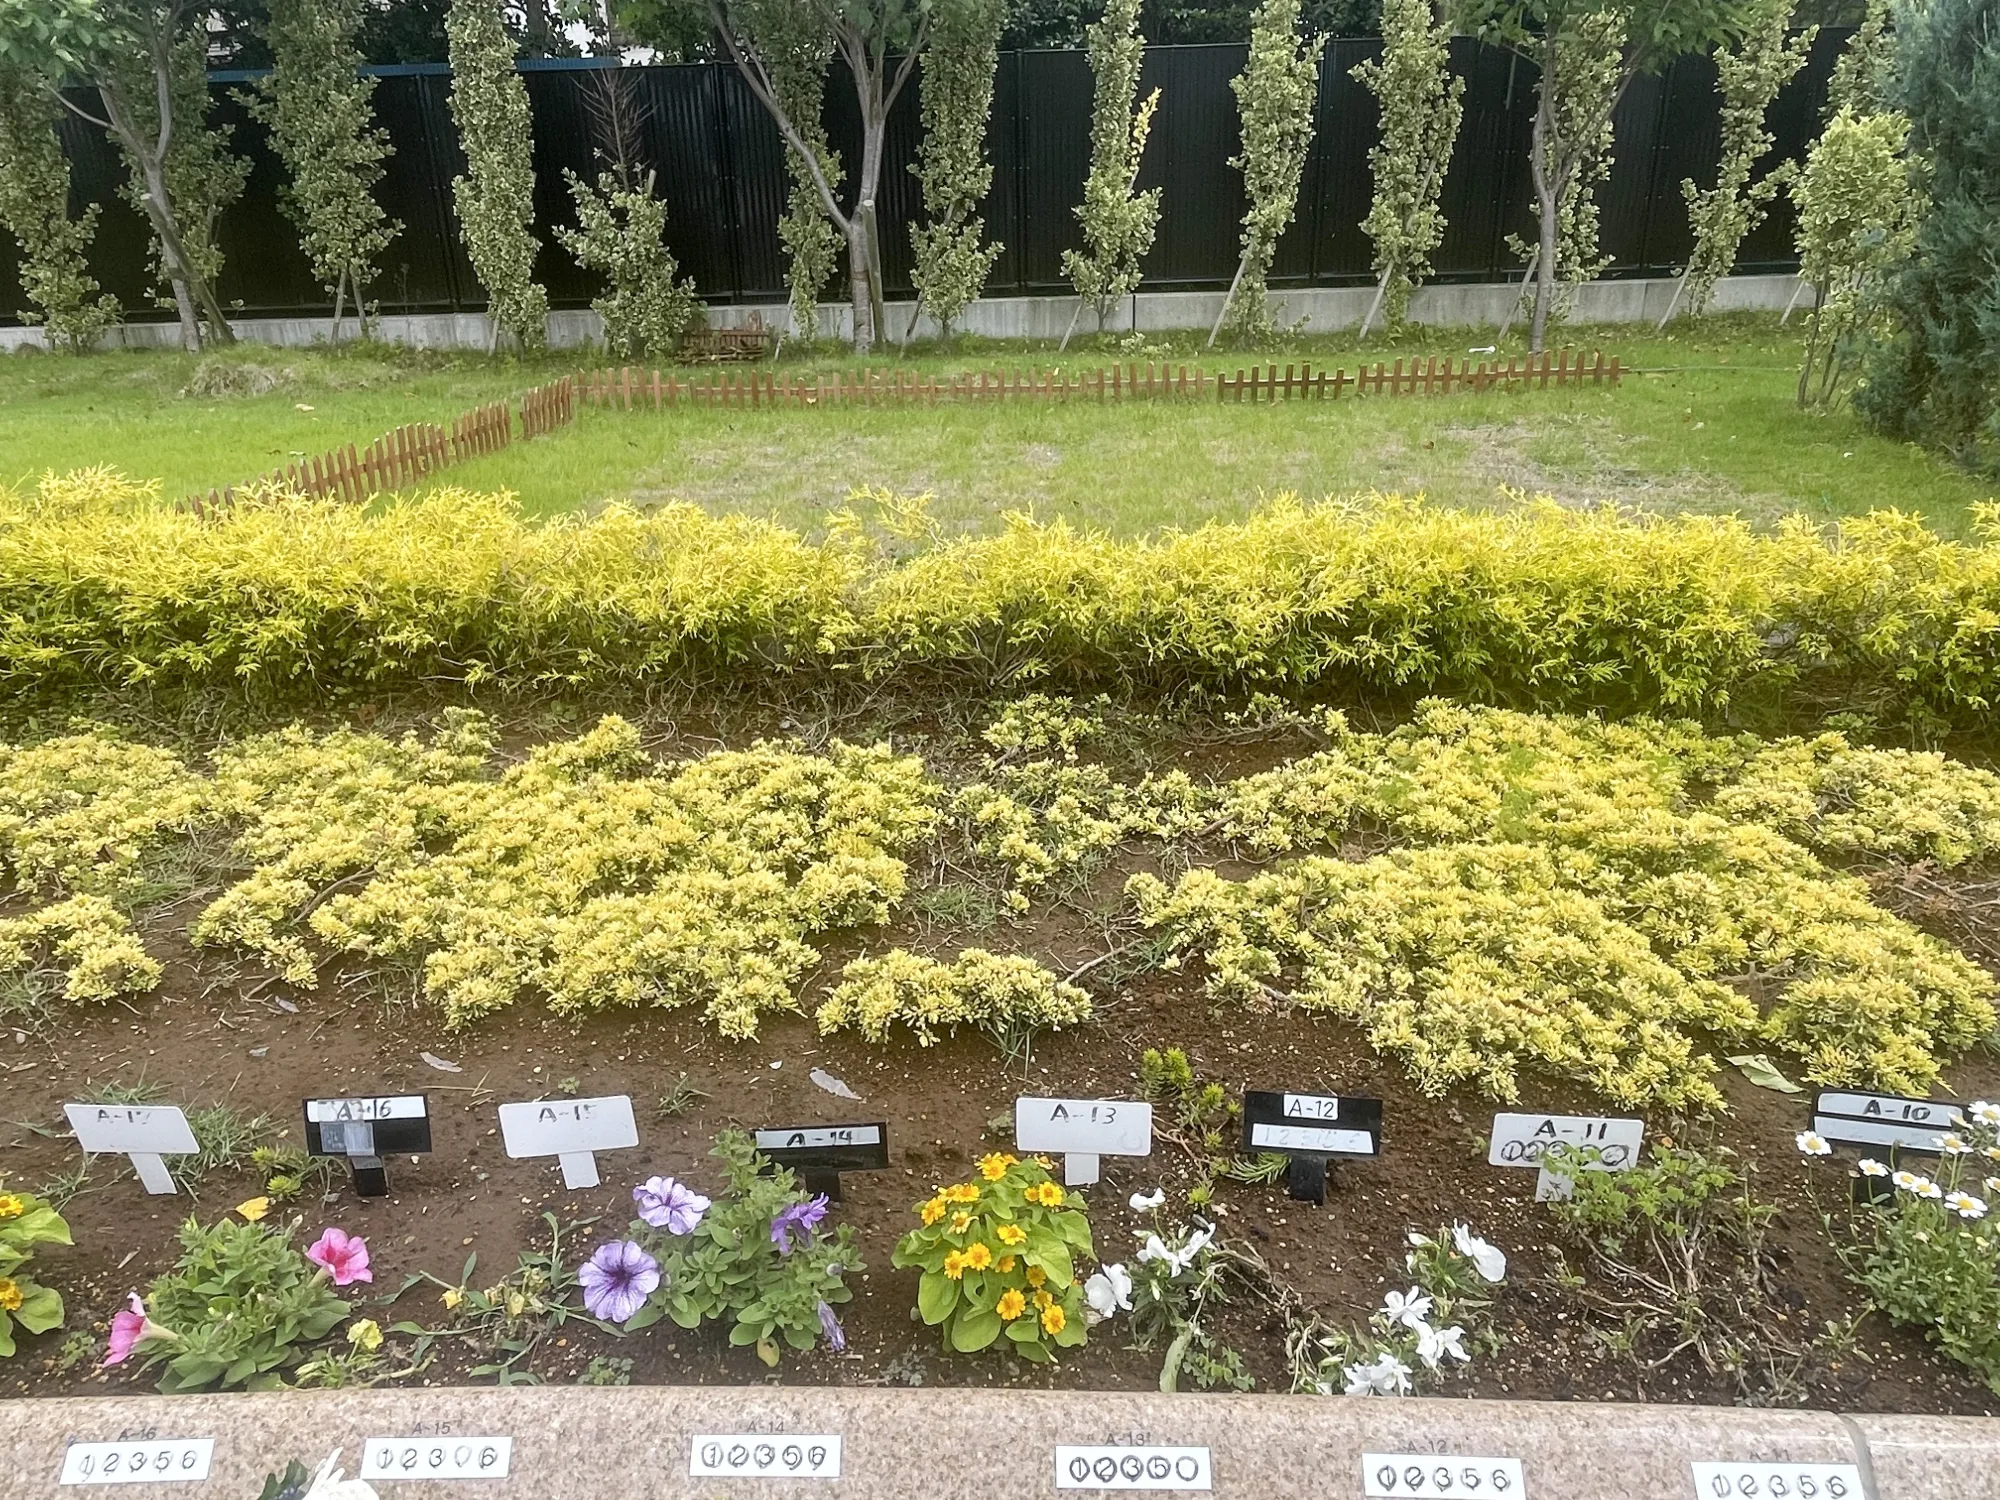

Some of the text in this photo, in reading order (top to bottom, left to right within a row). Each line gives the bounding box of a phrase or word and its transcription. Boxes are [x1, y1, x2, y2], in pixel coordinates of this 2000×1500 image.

[1050, 1103, 1117, 1125] A-13
[1288, 1098, 1335, 1118] A-12
[1863, 1099, 1931, 1121] A-10
[786, 1130, 853, 1147] A-14
[1534, 1119, 1608, 1140] A-11
[412, 1422, 451, 1435] A-15
[747, 1421, 785, 1433] A-14
